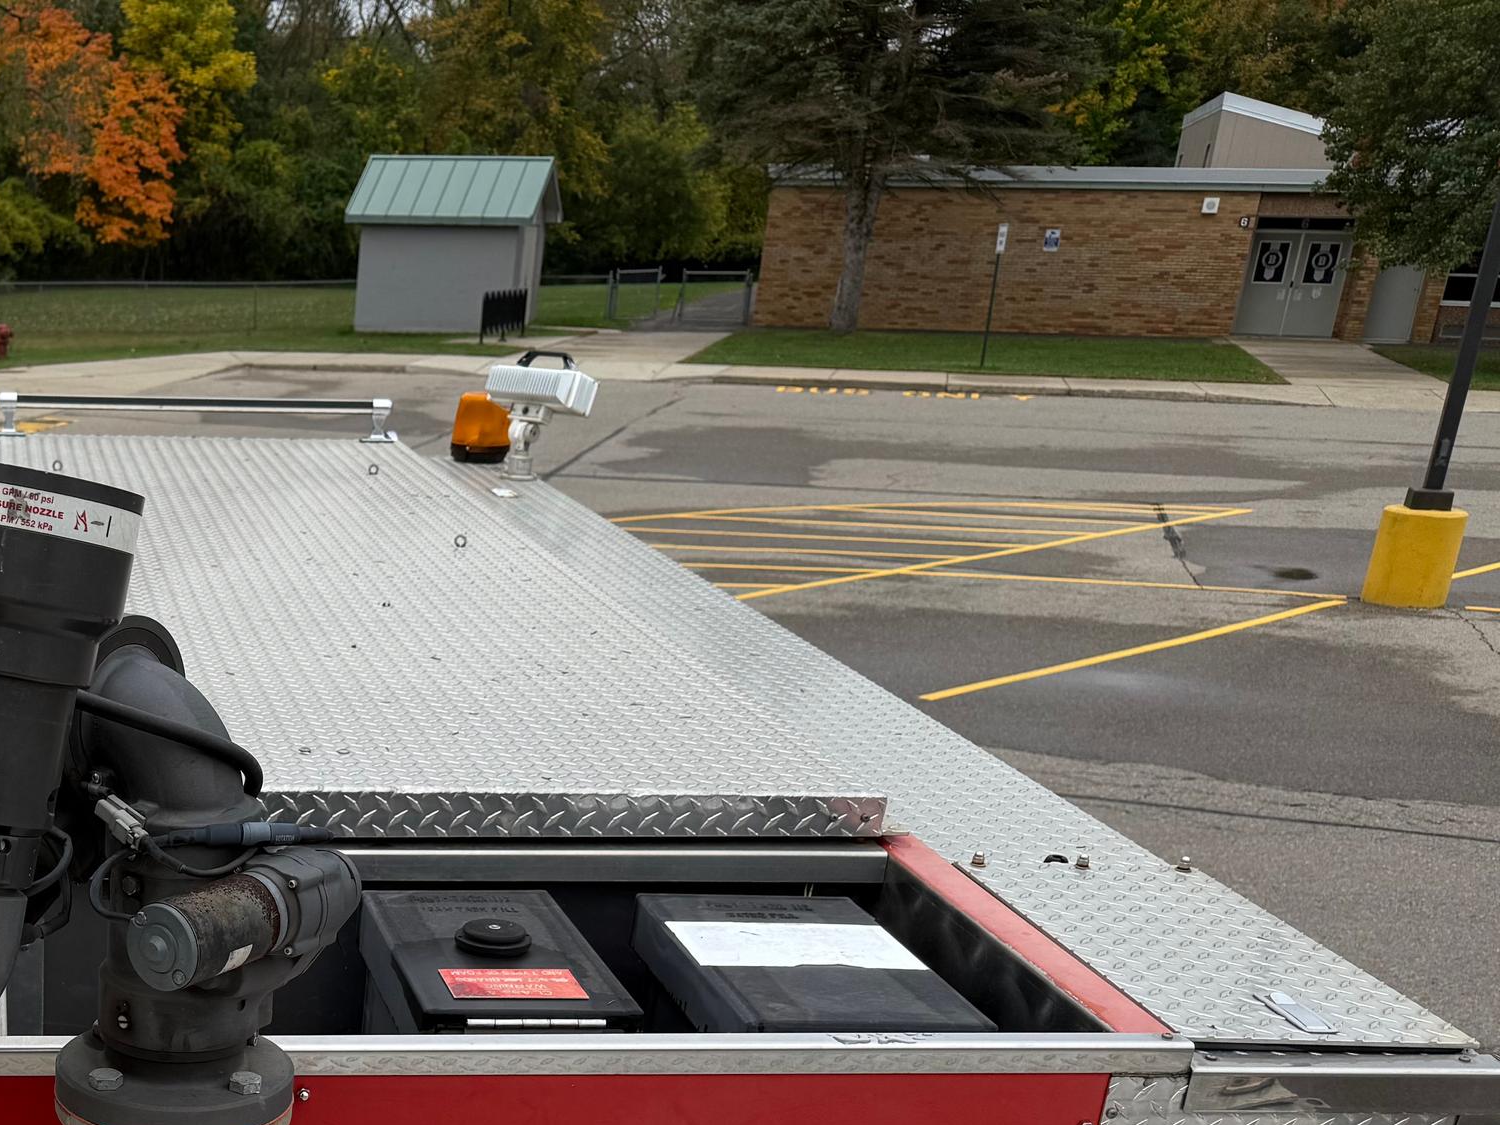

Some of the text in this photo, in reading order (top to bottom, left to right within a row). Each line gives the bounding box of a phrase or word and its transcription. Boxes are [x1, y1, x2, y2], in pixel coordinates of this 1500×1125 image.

[1240, 217, 1248, 227] 6
[2, 487, 22, 498] GPM
[29, 492, 40, 501] 80
[41, 496, 55, 505] psi
[25, 505, 65, 520] NOZZLE
[20, 518, 36, 528] 552
[37, 521, 53, 531] kPa
